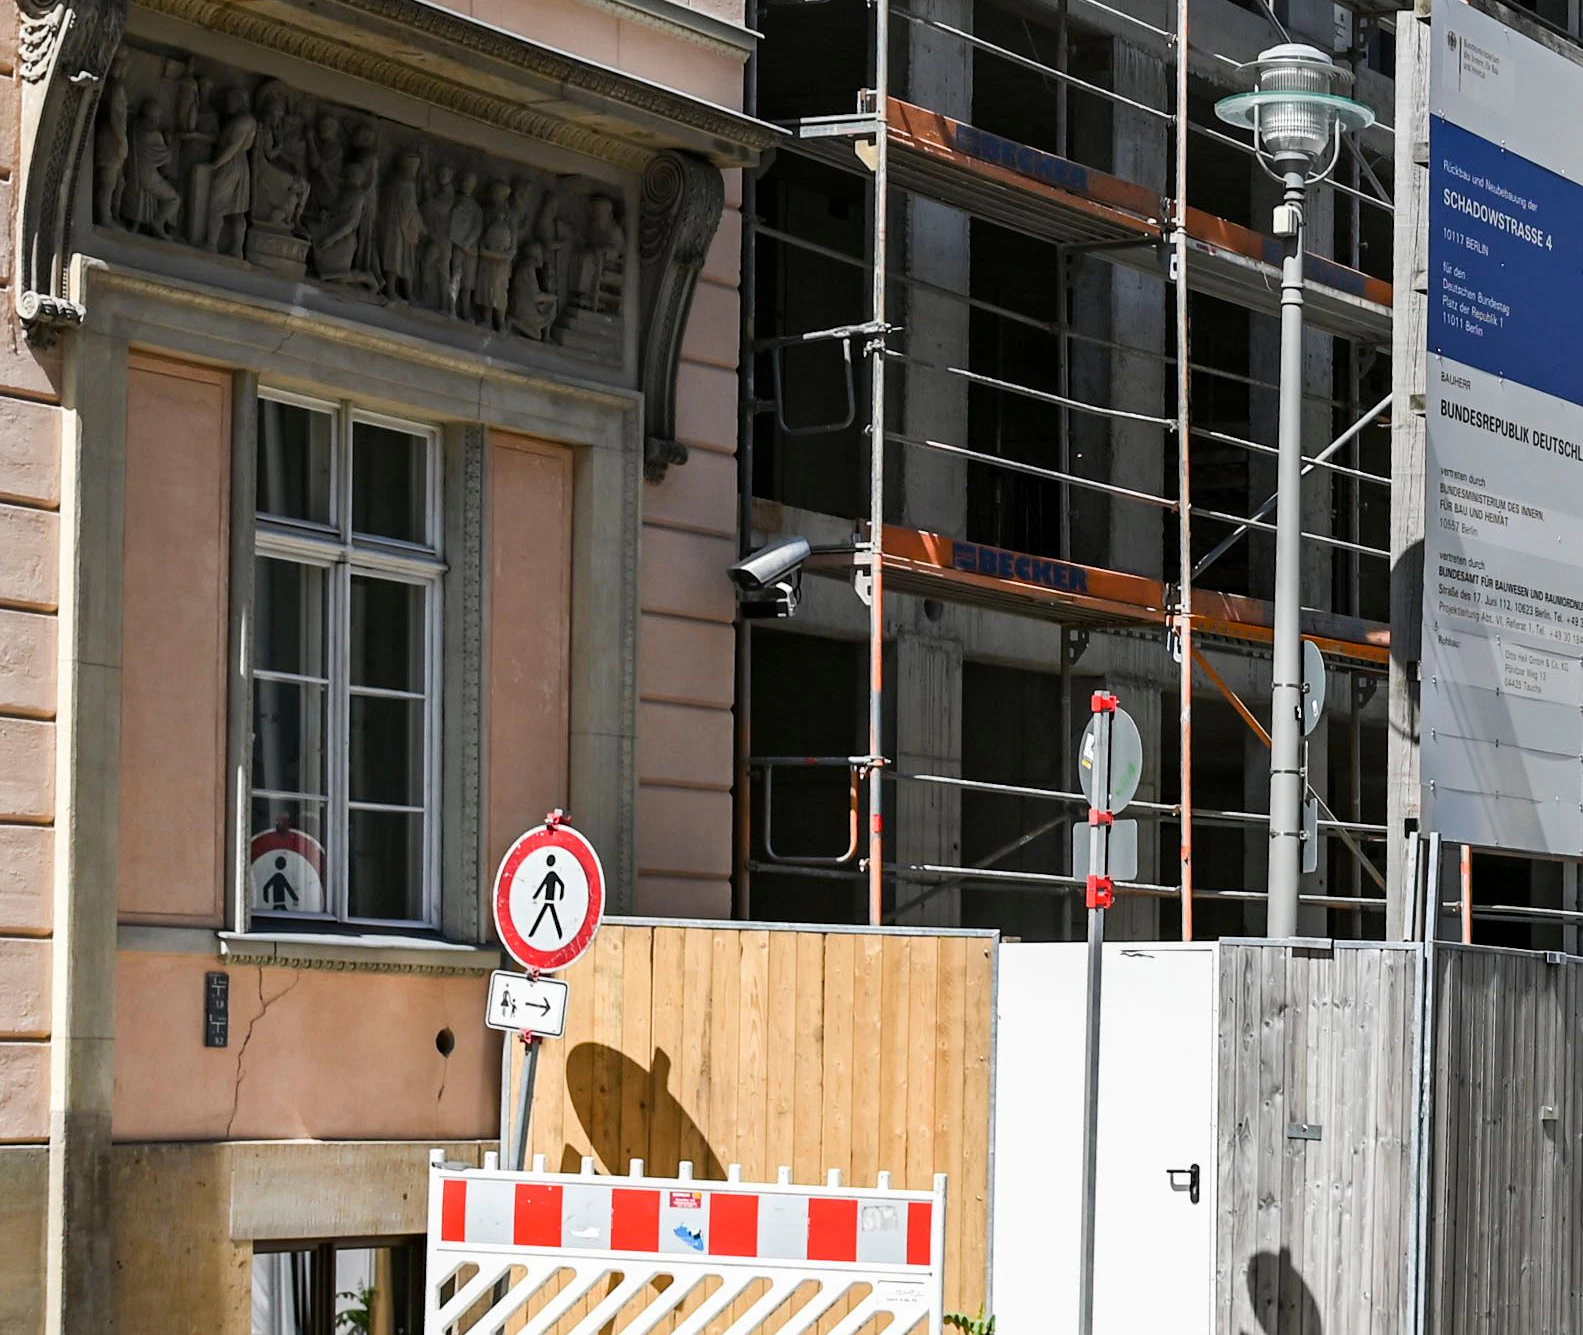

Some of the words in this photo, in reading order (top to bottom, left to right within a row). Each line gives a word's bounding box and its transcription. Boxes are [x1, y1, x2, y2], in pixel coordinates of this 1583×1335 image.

[1443, 159, 1471, 182] Rückbau
[1472, 175, 1484, 188] und
[1485, 178, 1527, 210] Neubebauung
[1527, 200, 1538, 212] der
[1443, 188, 1543, 247] SCHADOWSTRASSE
[1545, 234, 1553, 251] 4
[1443, 227, 1464, 245] 10117
[1466, 236, 1489, 256] BERLIN
[1443, 260, 1452, 274] für
[1453, 267, 1466, 280] den
[1442, 277, 1476, 300] Deutschen
[1477, 292, 1510, 317] Bundestag
[1442, 295, 1458, 311] Platz
[1459, 302, 1470, 315] der
[1471, 305, 1498, 326] Republik
[1443, 311, 1464, 329] 11011
[1465, 320, 1484, 337] Berlin
[1440, 370, 1470, 391] BAUHERR
[1440, 398, 1529, 444] BUNDESREPUBLIK
[1440, 465, 1467, 482] vertreten
[1468, 473, 1485, 488] durch
[1439, 481, 1505, 511] BUNDESMINISTERIUM
[1507, 501, 1519, 515] DES
[1440, 495, 1452, 512] FÜR
[1454, 502, 1468, 517] BAU
[1469, 506, 1482, 521] UND
[1484, 510, 1508, 528] HEIMAT
[1461, 522, 1478, 537] Berlin
[978, 546, 1088, 593] BECKER
[1439, 549, 1466, 566] vertreten
[1468, 557, 1485, 571] durch
[1438, 565, 1478, 586] BUNDESAMT
[1481, 573, 1493, 589] FÜR
[1495, 579, 1528, 598] BAUWESEN
[1530, 588, 1543, 601] UND
[1438, 583, 1458, 599] Straße
[1460, 588, 1471, 601] des
